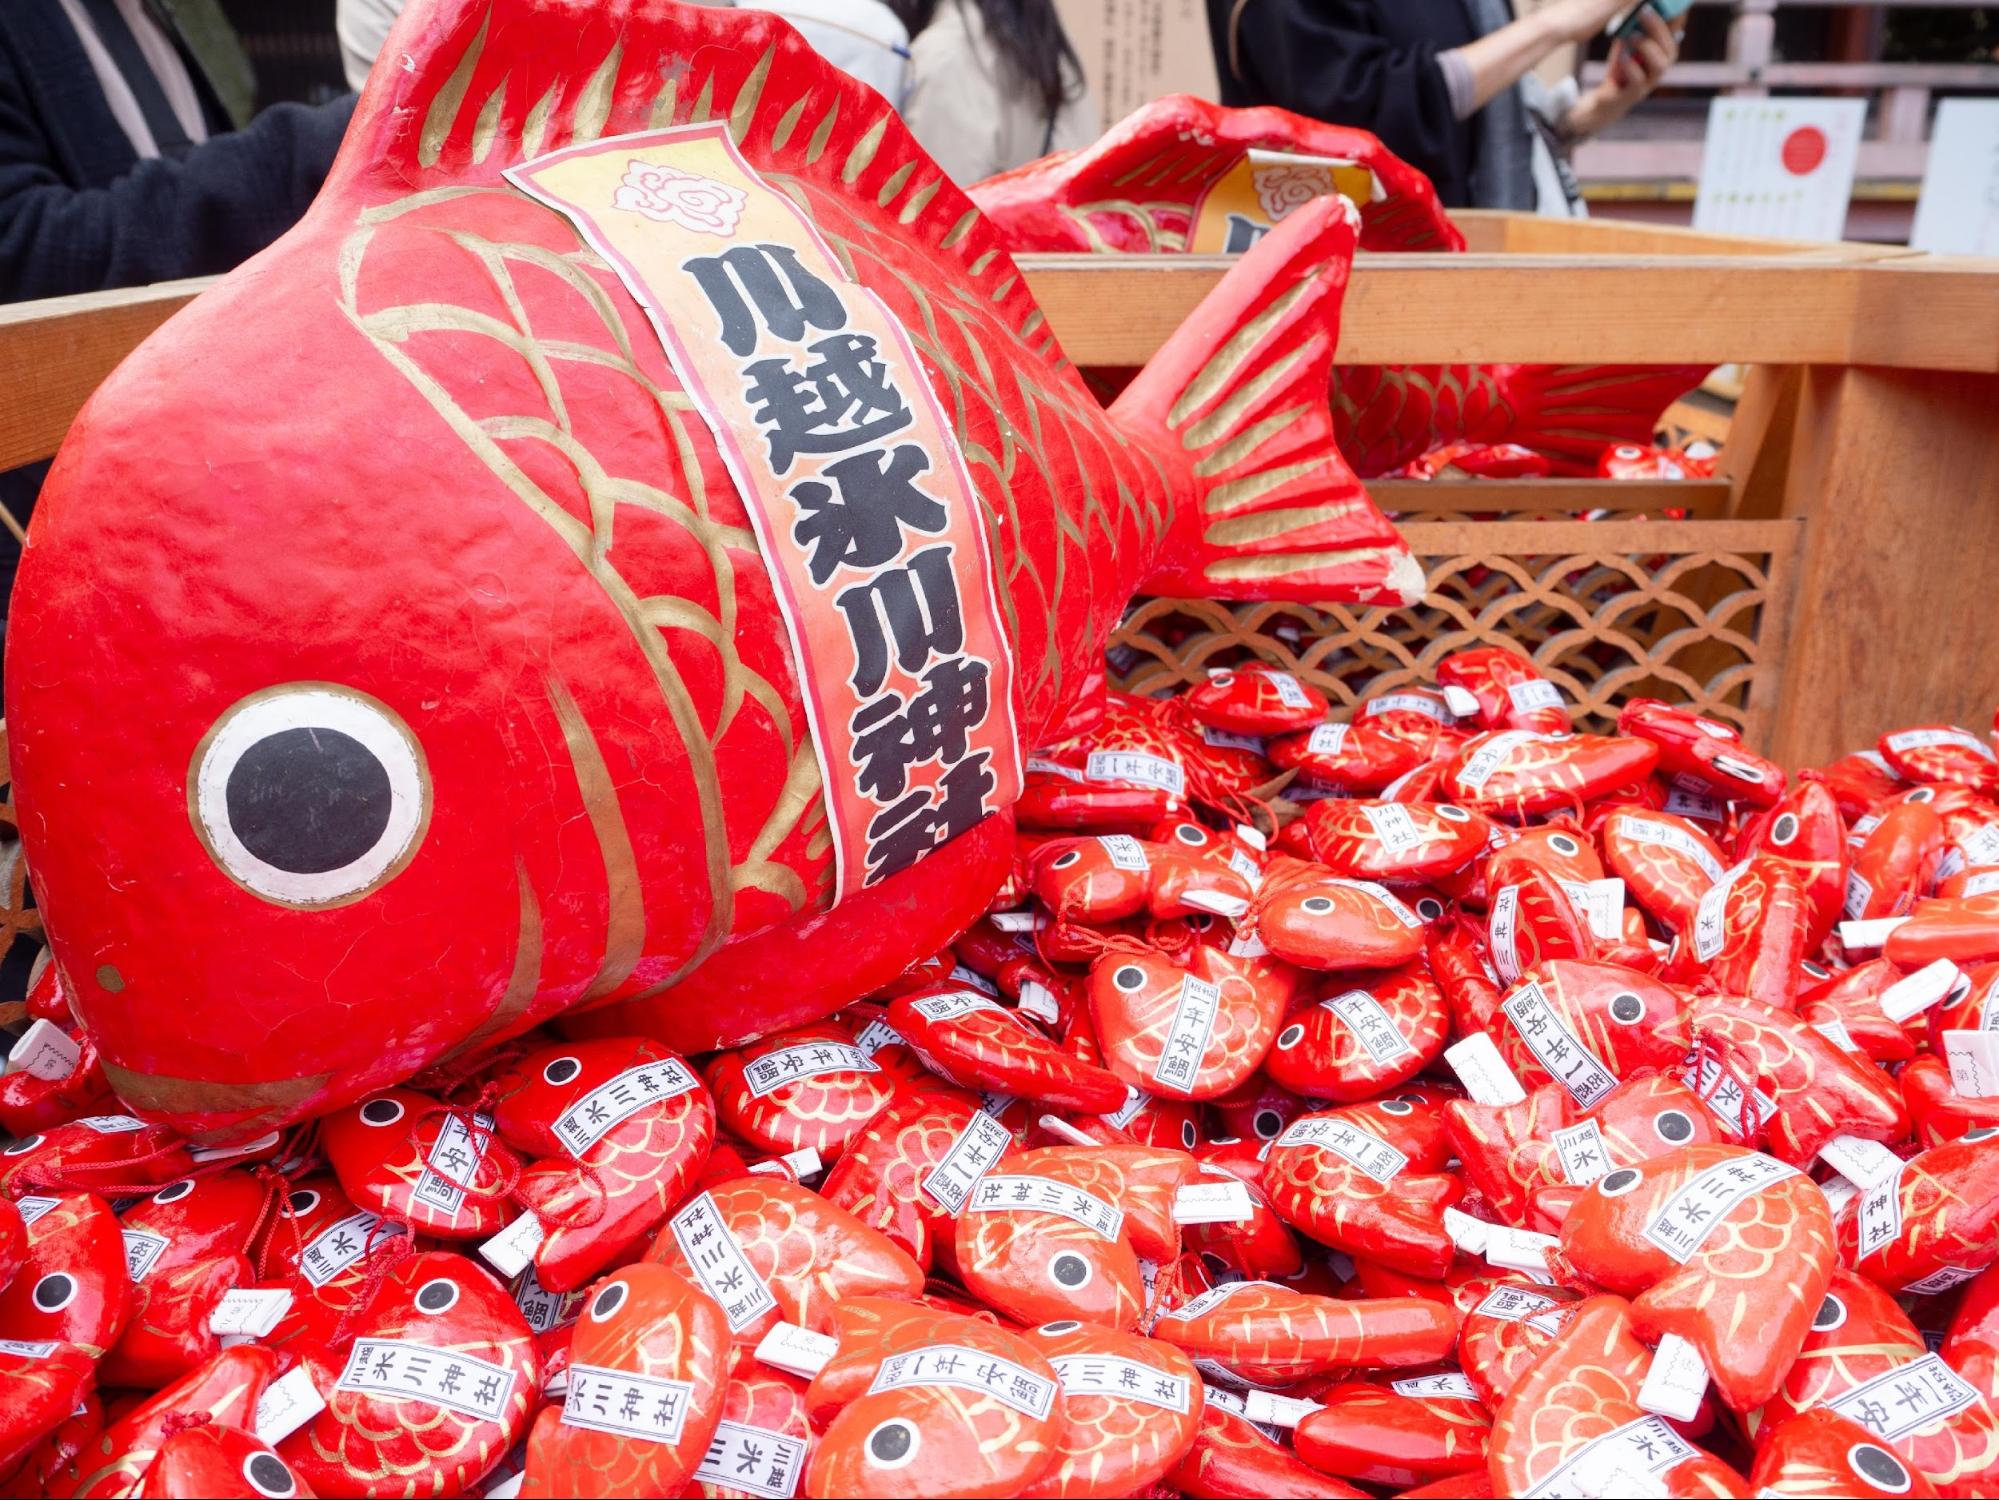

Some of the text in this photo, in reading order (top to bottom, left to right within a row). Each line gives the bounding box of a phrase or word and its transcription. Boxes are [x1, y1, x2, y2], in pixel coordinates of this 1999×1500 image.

[684, 244, 996, 886] 川越氷川神社
[1563, 1129, 1602, 1184] 川越氷
